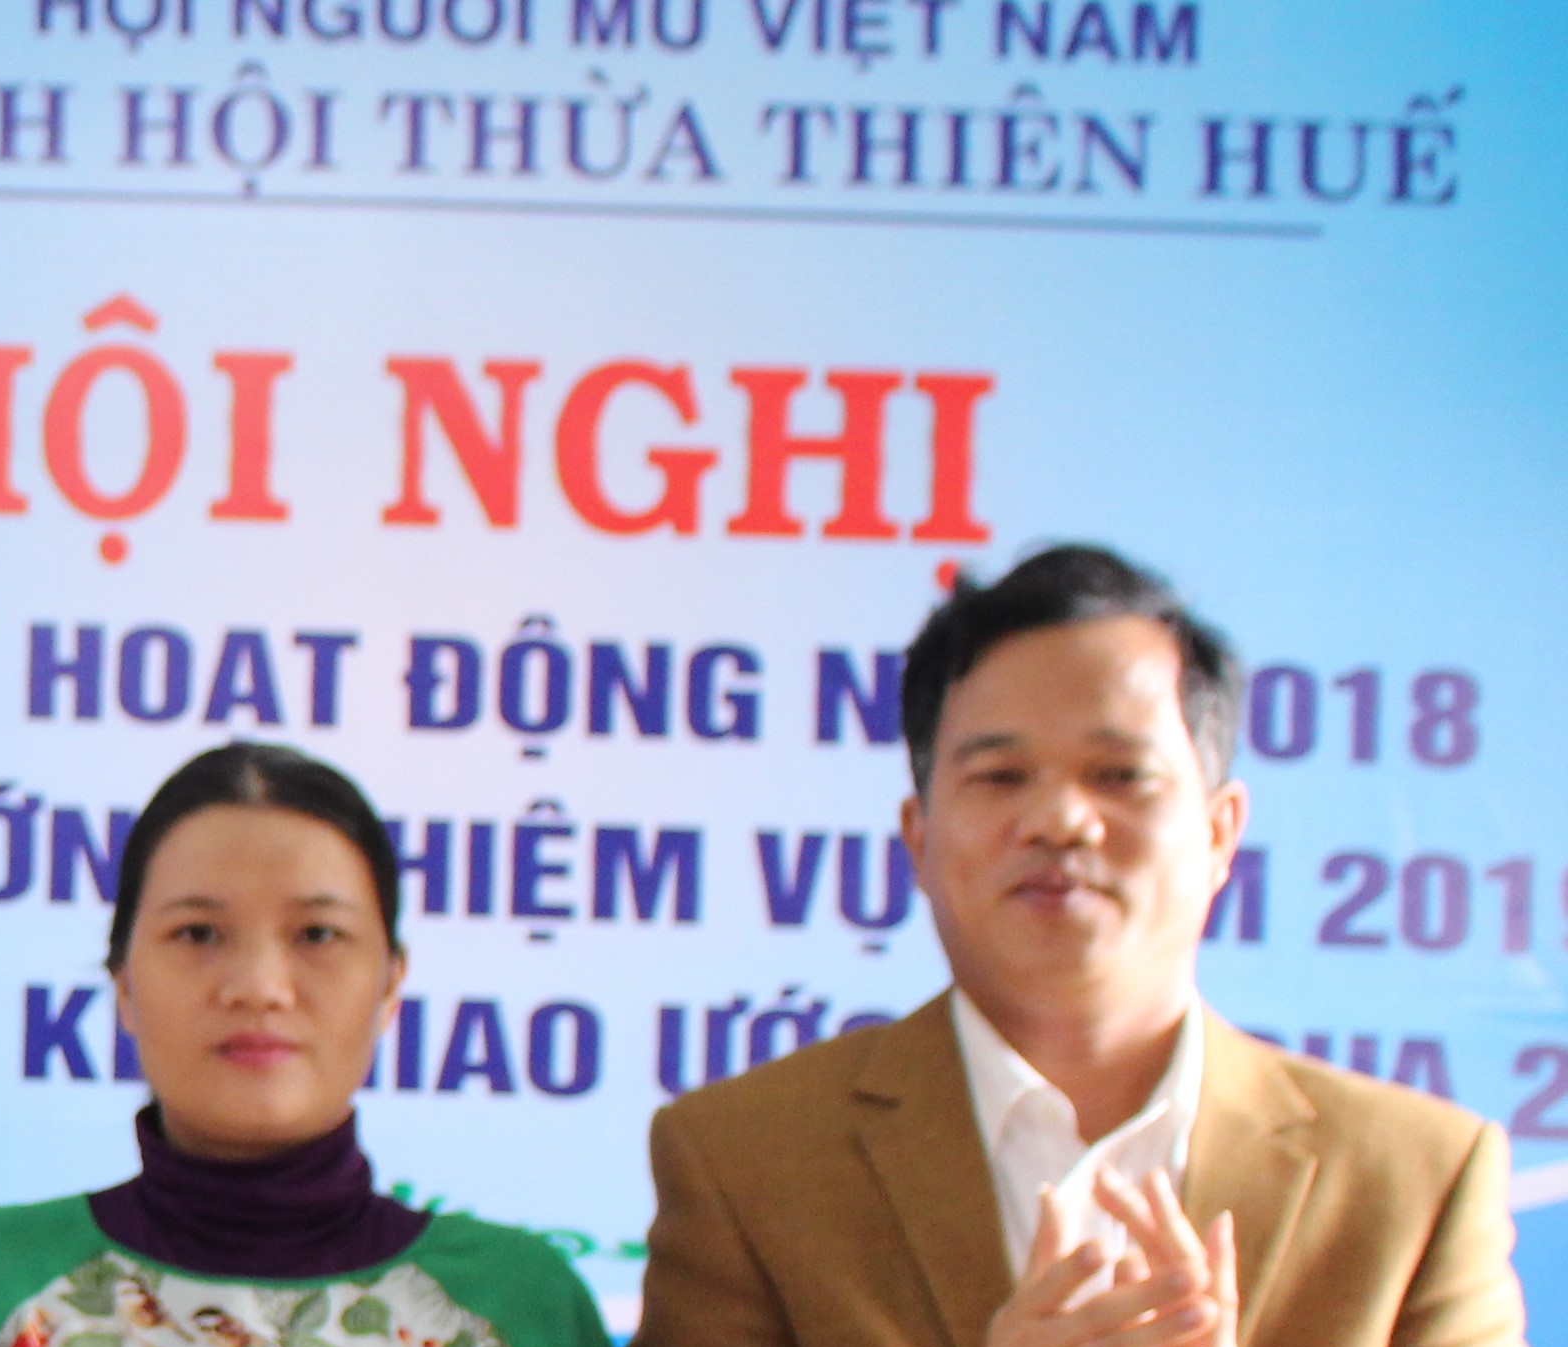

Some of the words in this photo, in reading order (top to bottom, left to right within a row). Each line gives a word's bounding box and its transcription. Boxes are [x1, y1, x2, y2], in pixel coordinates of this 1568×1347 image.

[993, 0, 1201, 64] NAM
[119, 60, 340, 198] HỘI
[380, 68, 723, 183] THỪA
[761, 84, 1153, 197] THIÊN
[1198, 86, 1467, 206] HUẾ
[379, 354, 997, 595] NGHỊ
[402, 616, 761, 760] ĐỘNG
[1239, 664, 1480, 768] 018
[381, 799, 705, 943] HIỆM
[754, 828, 920, 953] VỤ
[1317, 850, 1568, 954] 201
[349, 996, 602, 1098] IAO
[655, 984, 899, 1096] ƯỚ
